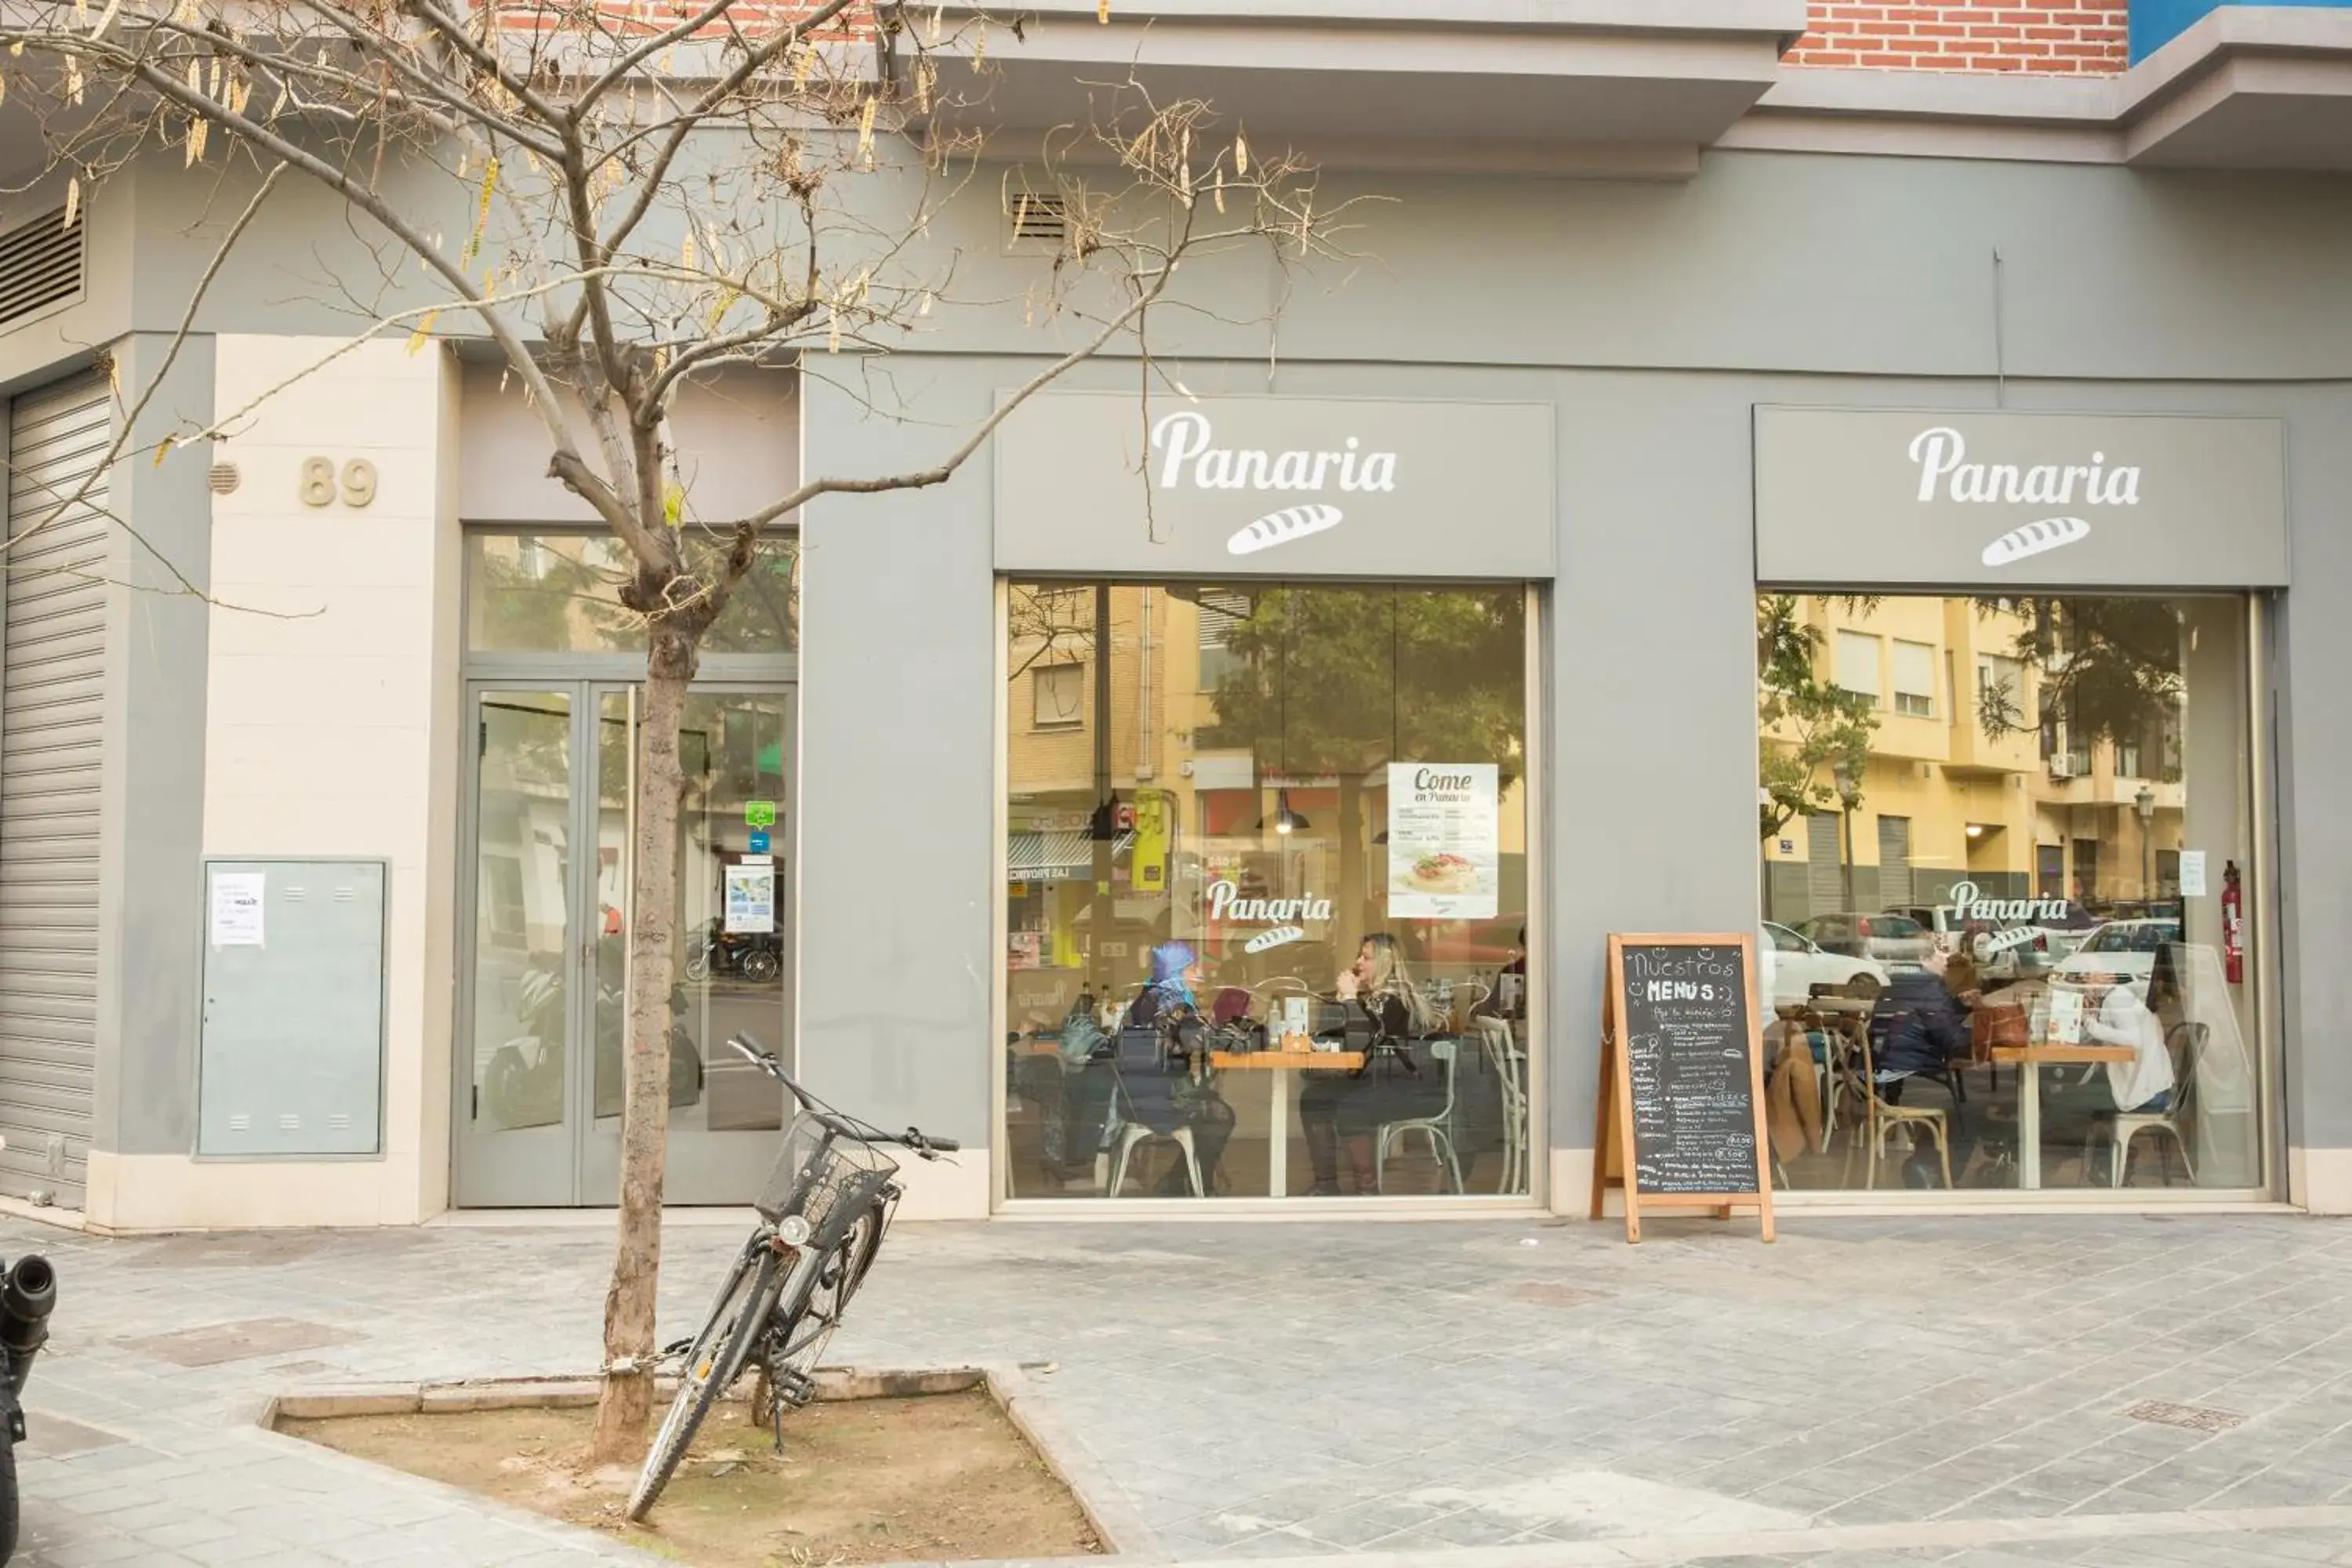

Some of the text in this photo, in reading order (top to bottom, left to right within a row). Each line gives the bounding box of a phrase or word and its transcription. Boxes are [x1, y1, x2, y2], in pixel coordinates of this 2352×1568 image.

[1152, 411, 1397, 492] Panaria
[1908, 426, 2141, 506] Panaria
[299, 456, 377, 507] 89
[1414, 768, 1472, 791] Come
[1414, 793, 1426, 802] en
[1207, 880, 1330, 920] Panaria
[1950, 880, 2068, 920] Panaria
